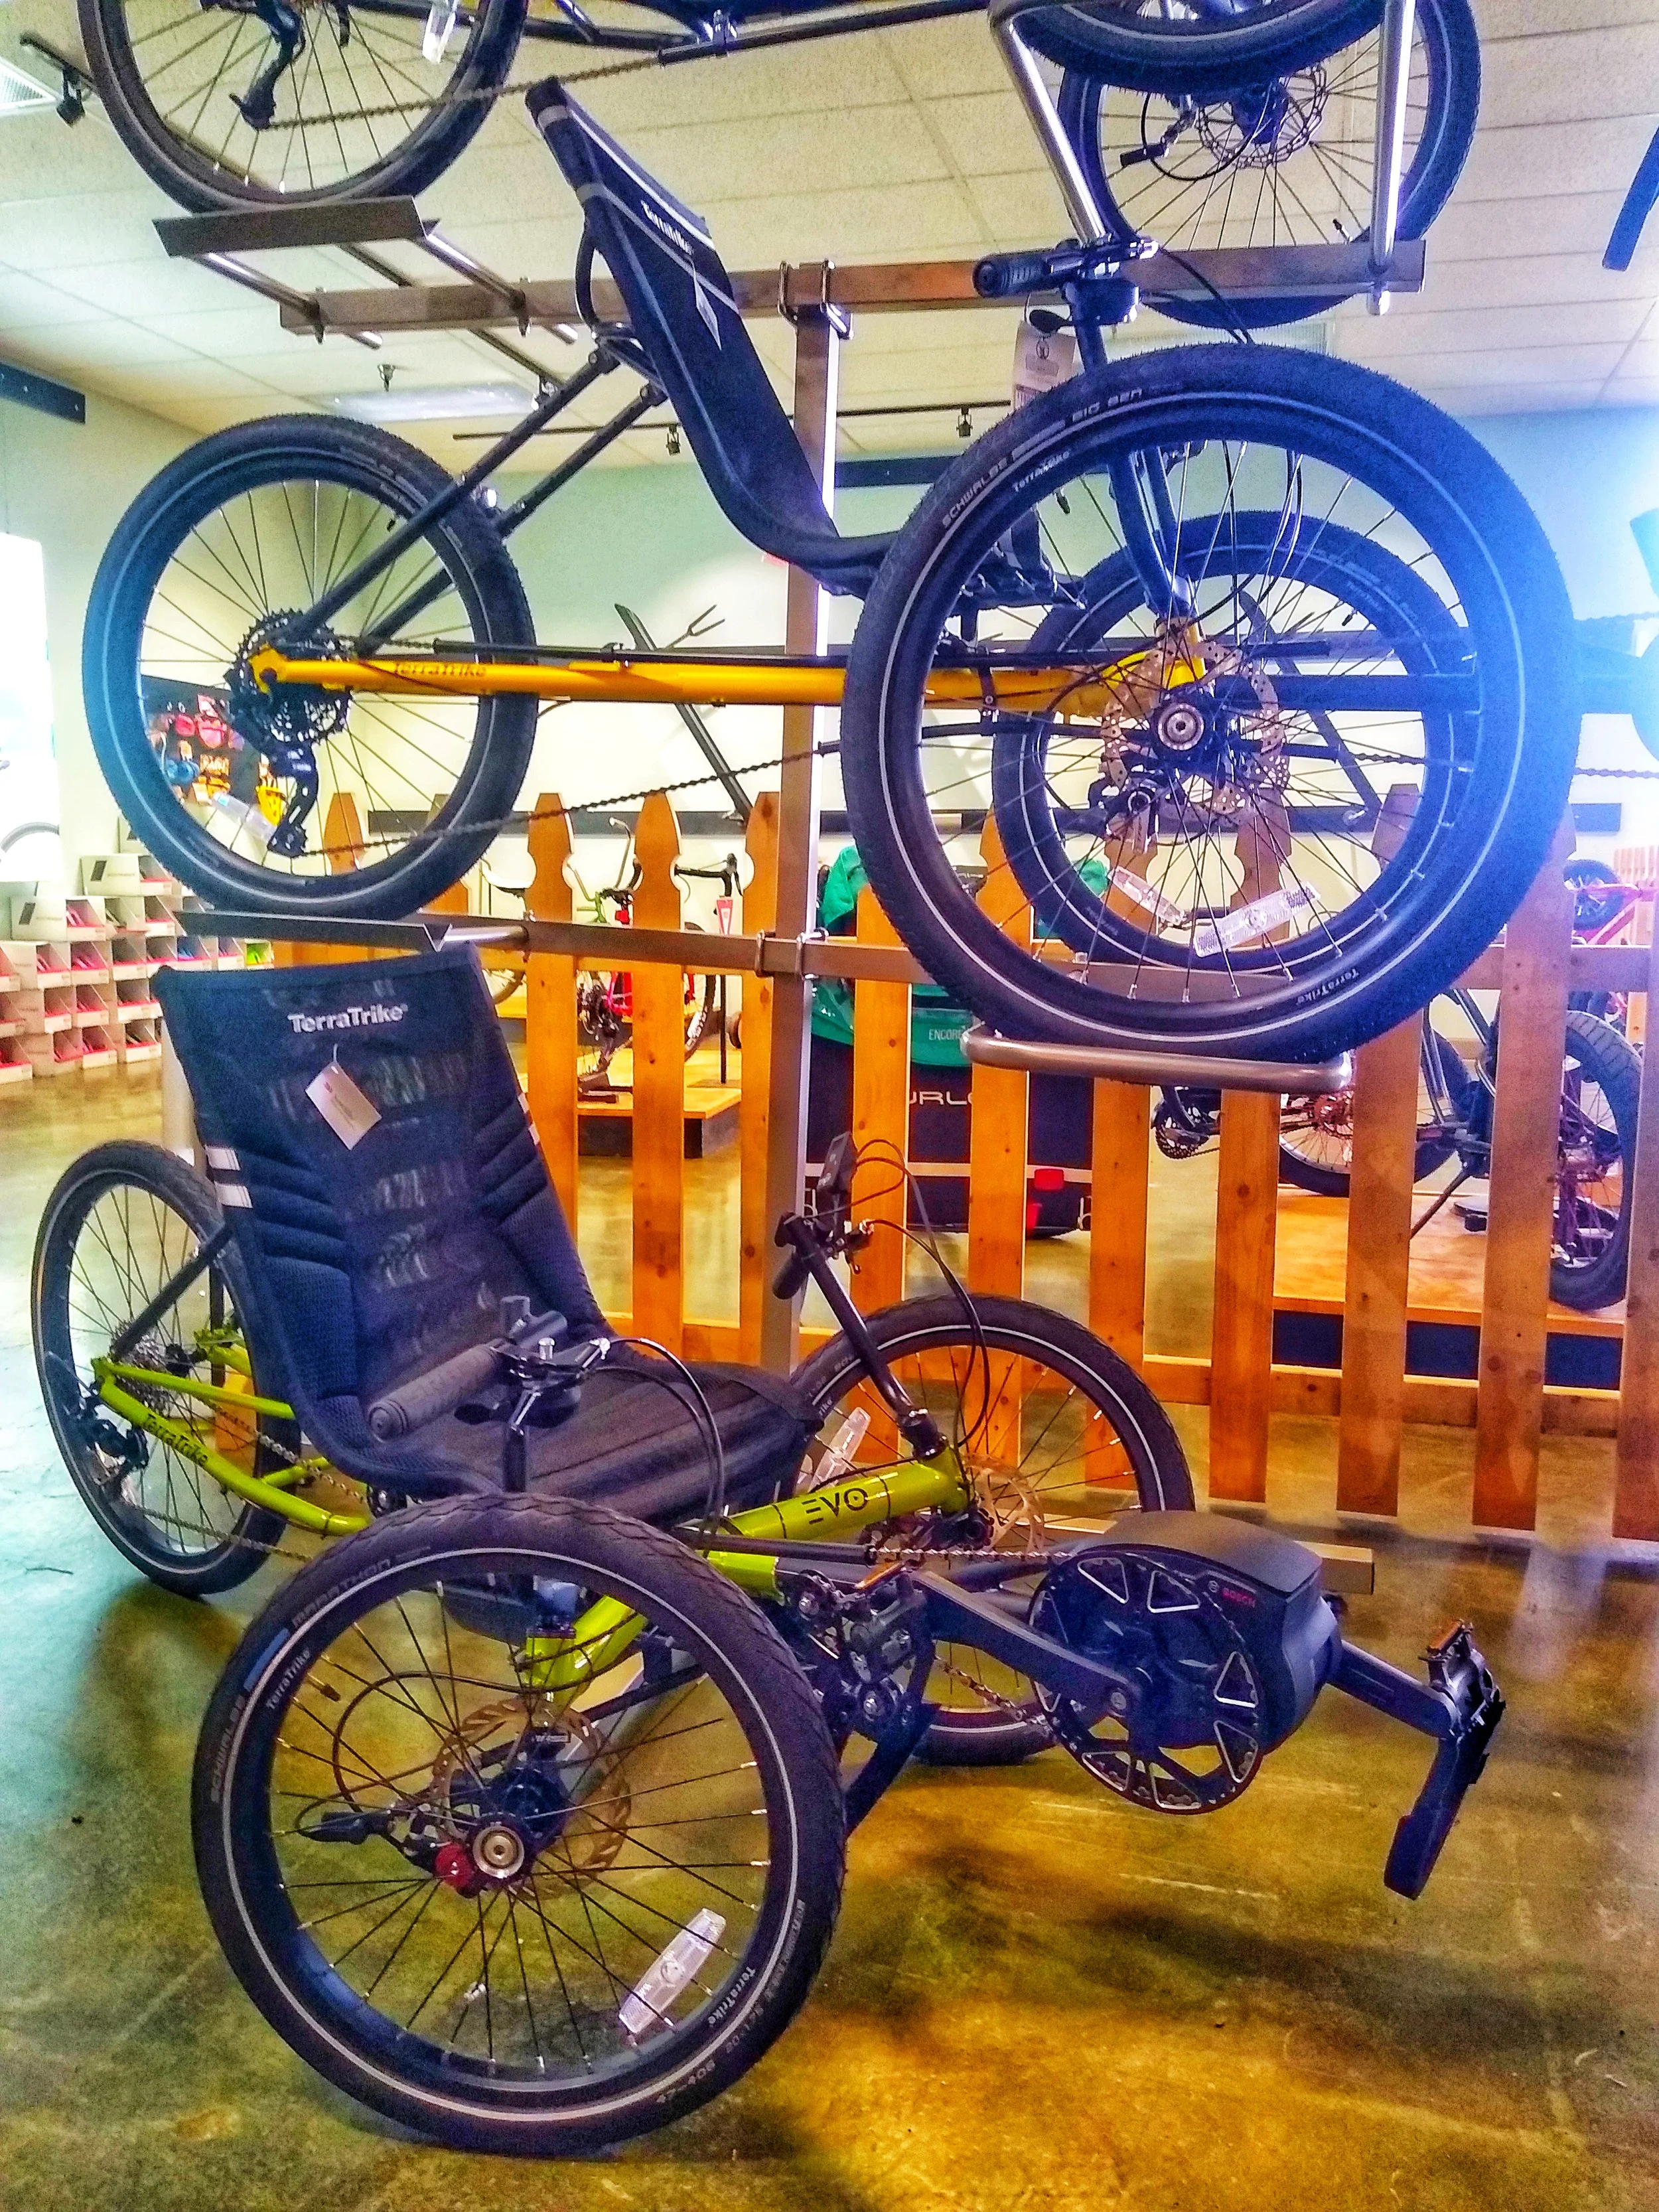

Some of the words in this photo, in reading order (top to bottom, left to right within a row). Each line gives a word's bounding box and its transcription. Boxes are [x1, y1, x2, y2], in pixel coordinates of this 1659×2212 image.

[1295, 968, 1360, 1007] TerraTrike
[287, 1003, 409, 1034] TerraTrike
[147, 1412, 208, 1463] TerraTrike
[801, 1488, 869, 1525] EVO
[265, 1646, 312, 1710] TerraTrike
[707, 1966, 756, 2028] TerraTrike
